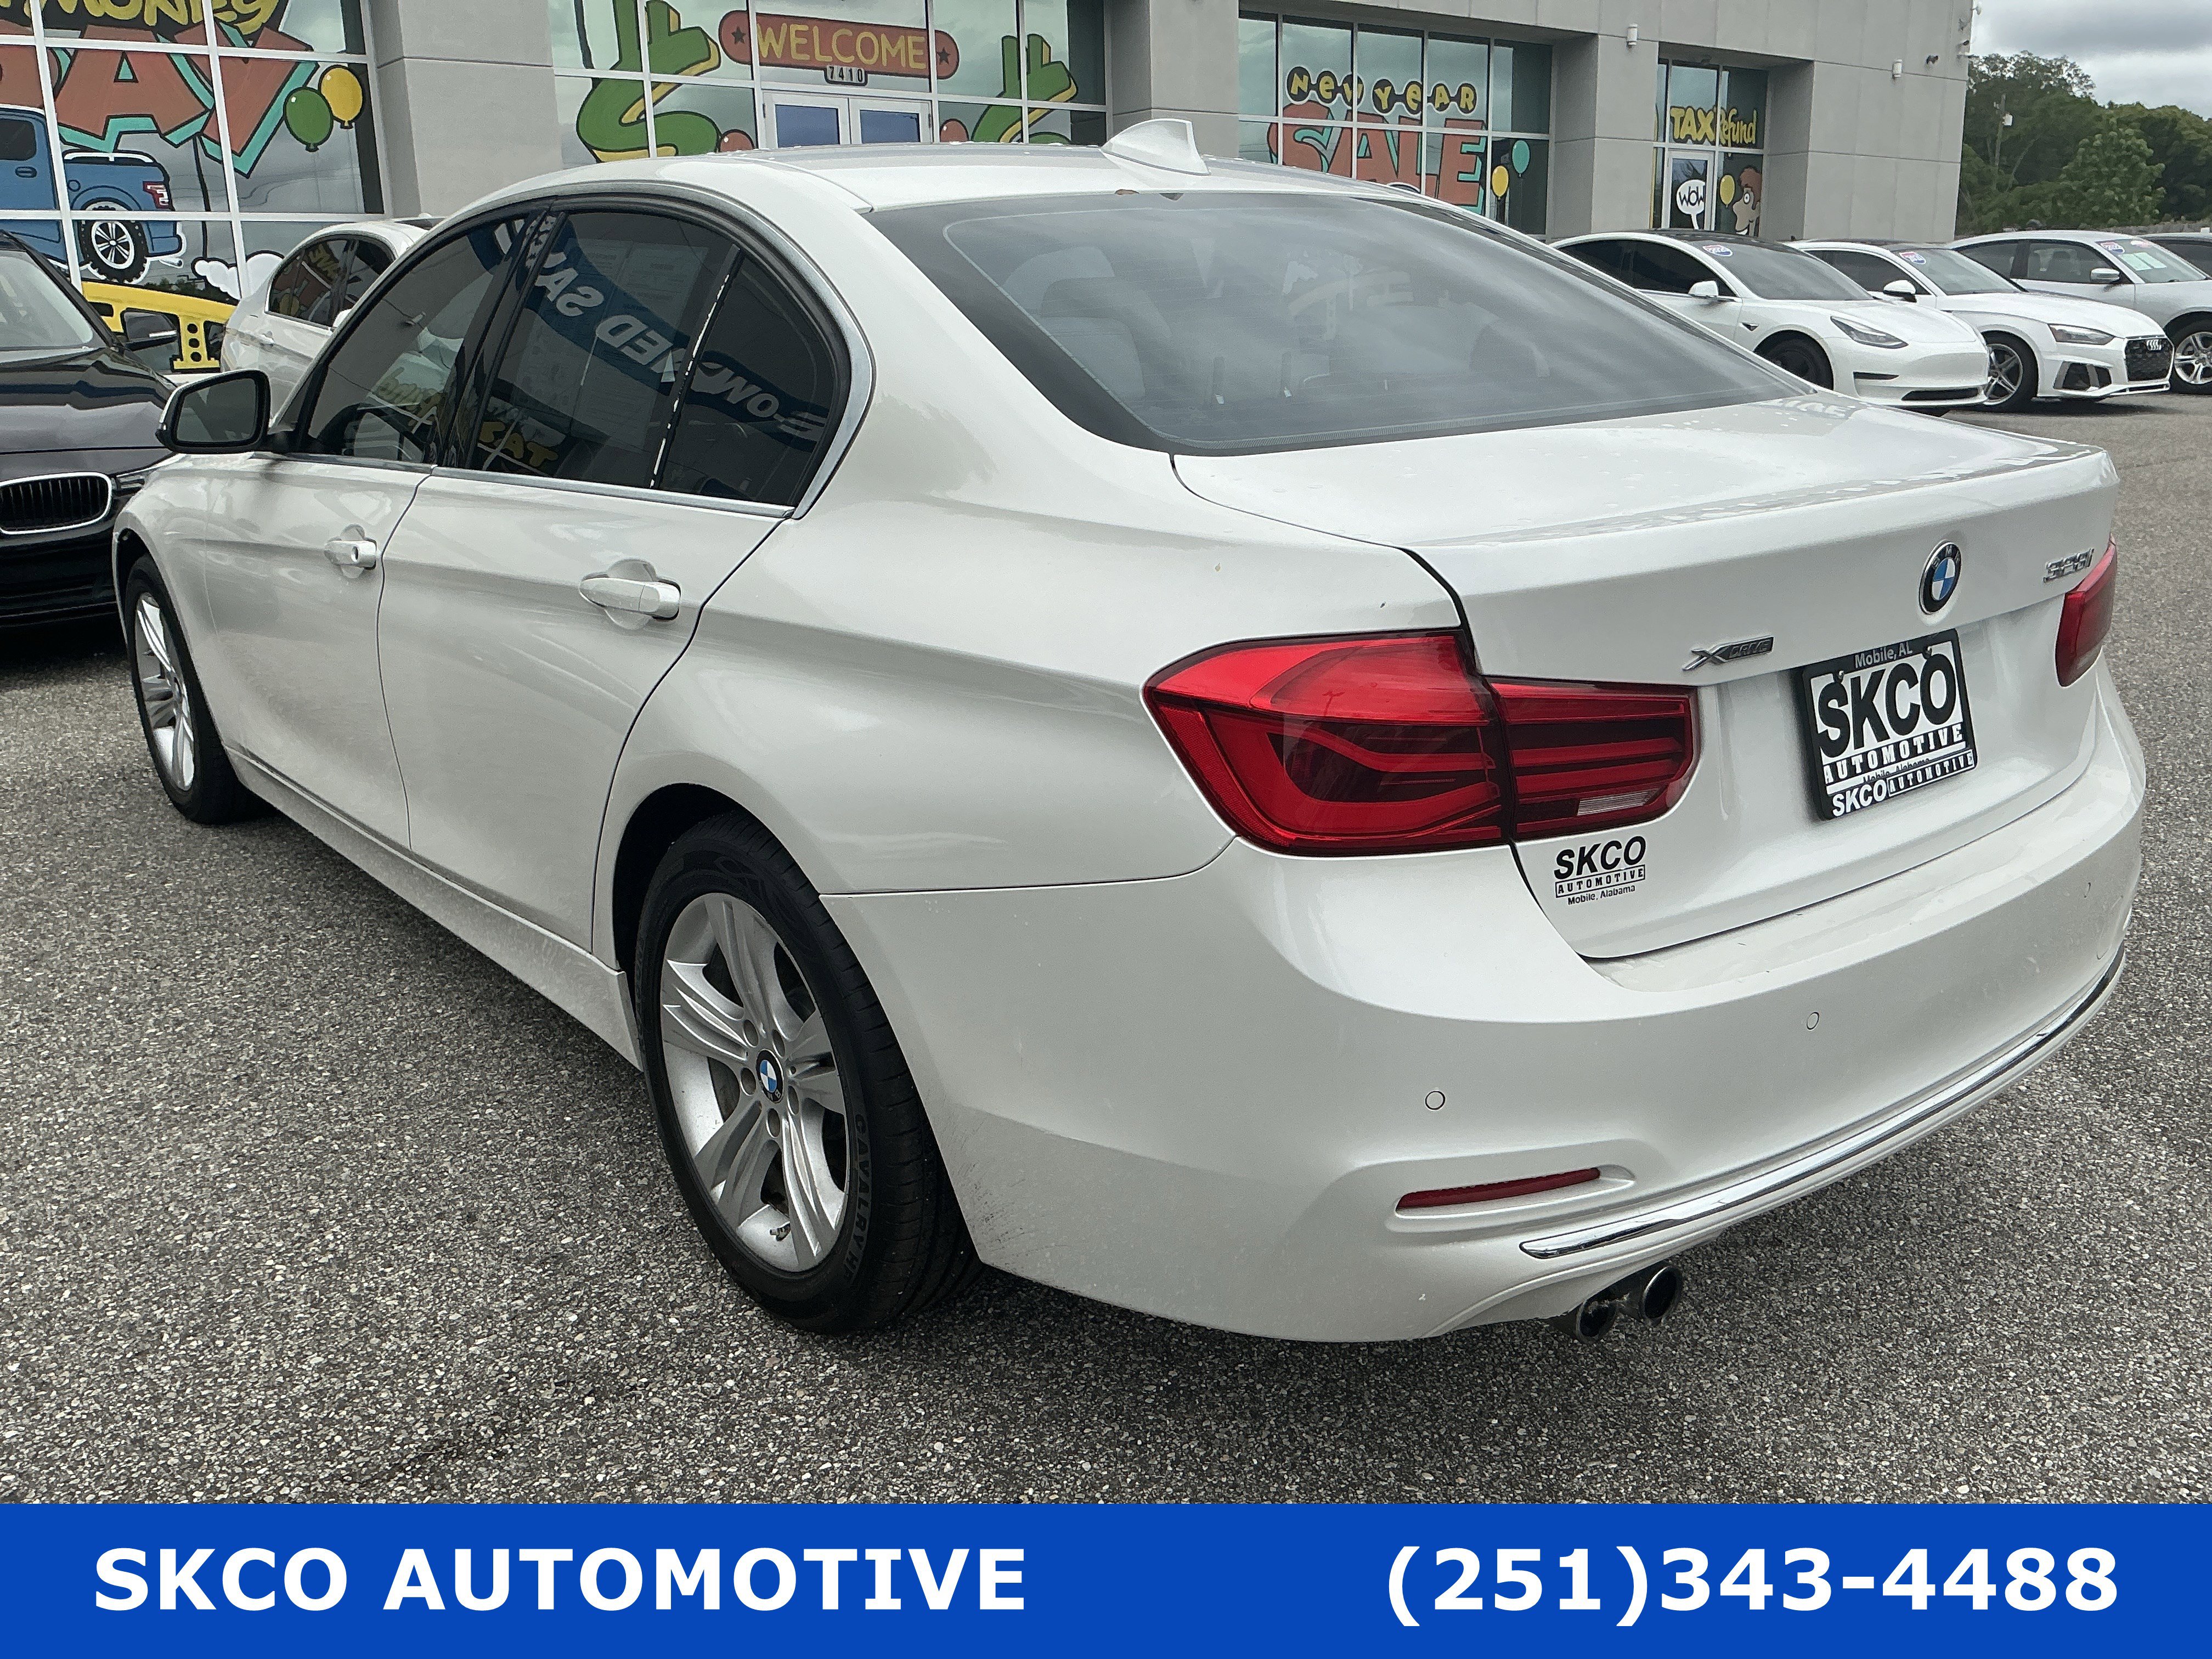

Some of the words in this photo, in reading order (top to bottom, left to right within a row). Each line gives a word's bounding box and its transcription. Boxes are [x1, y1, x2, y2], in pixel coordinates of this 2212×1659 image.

[757, 22, 928, 70] WELCOME
[828, 65, 864, 83] 7410
[1671, 108, 1715, 141] TAX
[1267, 101, 1486, 211] SALE
[1855, 648, 1898, 669] Mobile,
[1898, 641, 1913, 656] AL
[1817, 653, 1956, 758] SKCO
[1823, 723, 1963, 785] AUTOMOTIVE
[1832, 778, 1887, 817] SKCO
[1889, 752, 1974, 793] AUTOMOTIVE
[1554, 836, 1646, 879] SKCO
[1558, 868, 1644, 894] AUTOMOTIVE
[1567, 892, 1599, 905] Mobile,
[1600, 885, 1635, 899] Alabama
[853, 1113, 871, 1251] CAVALRY
